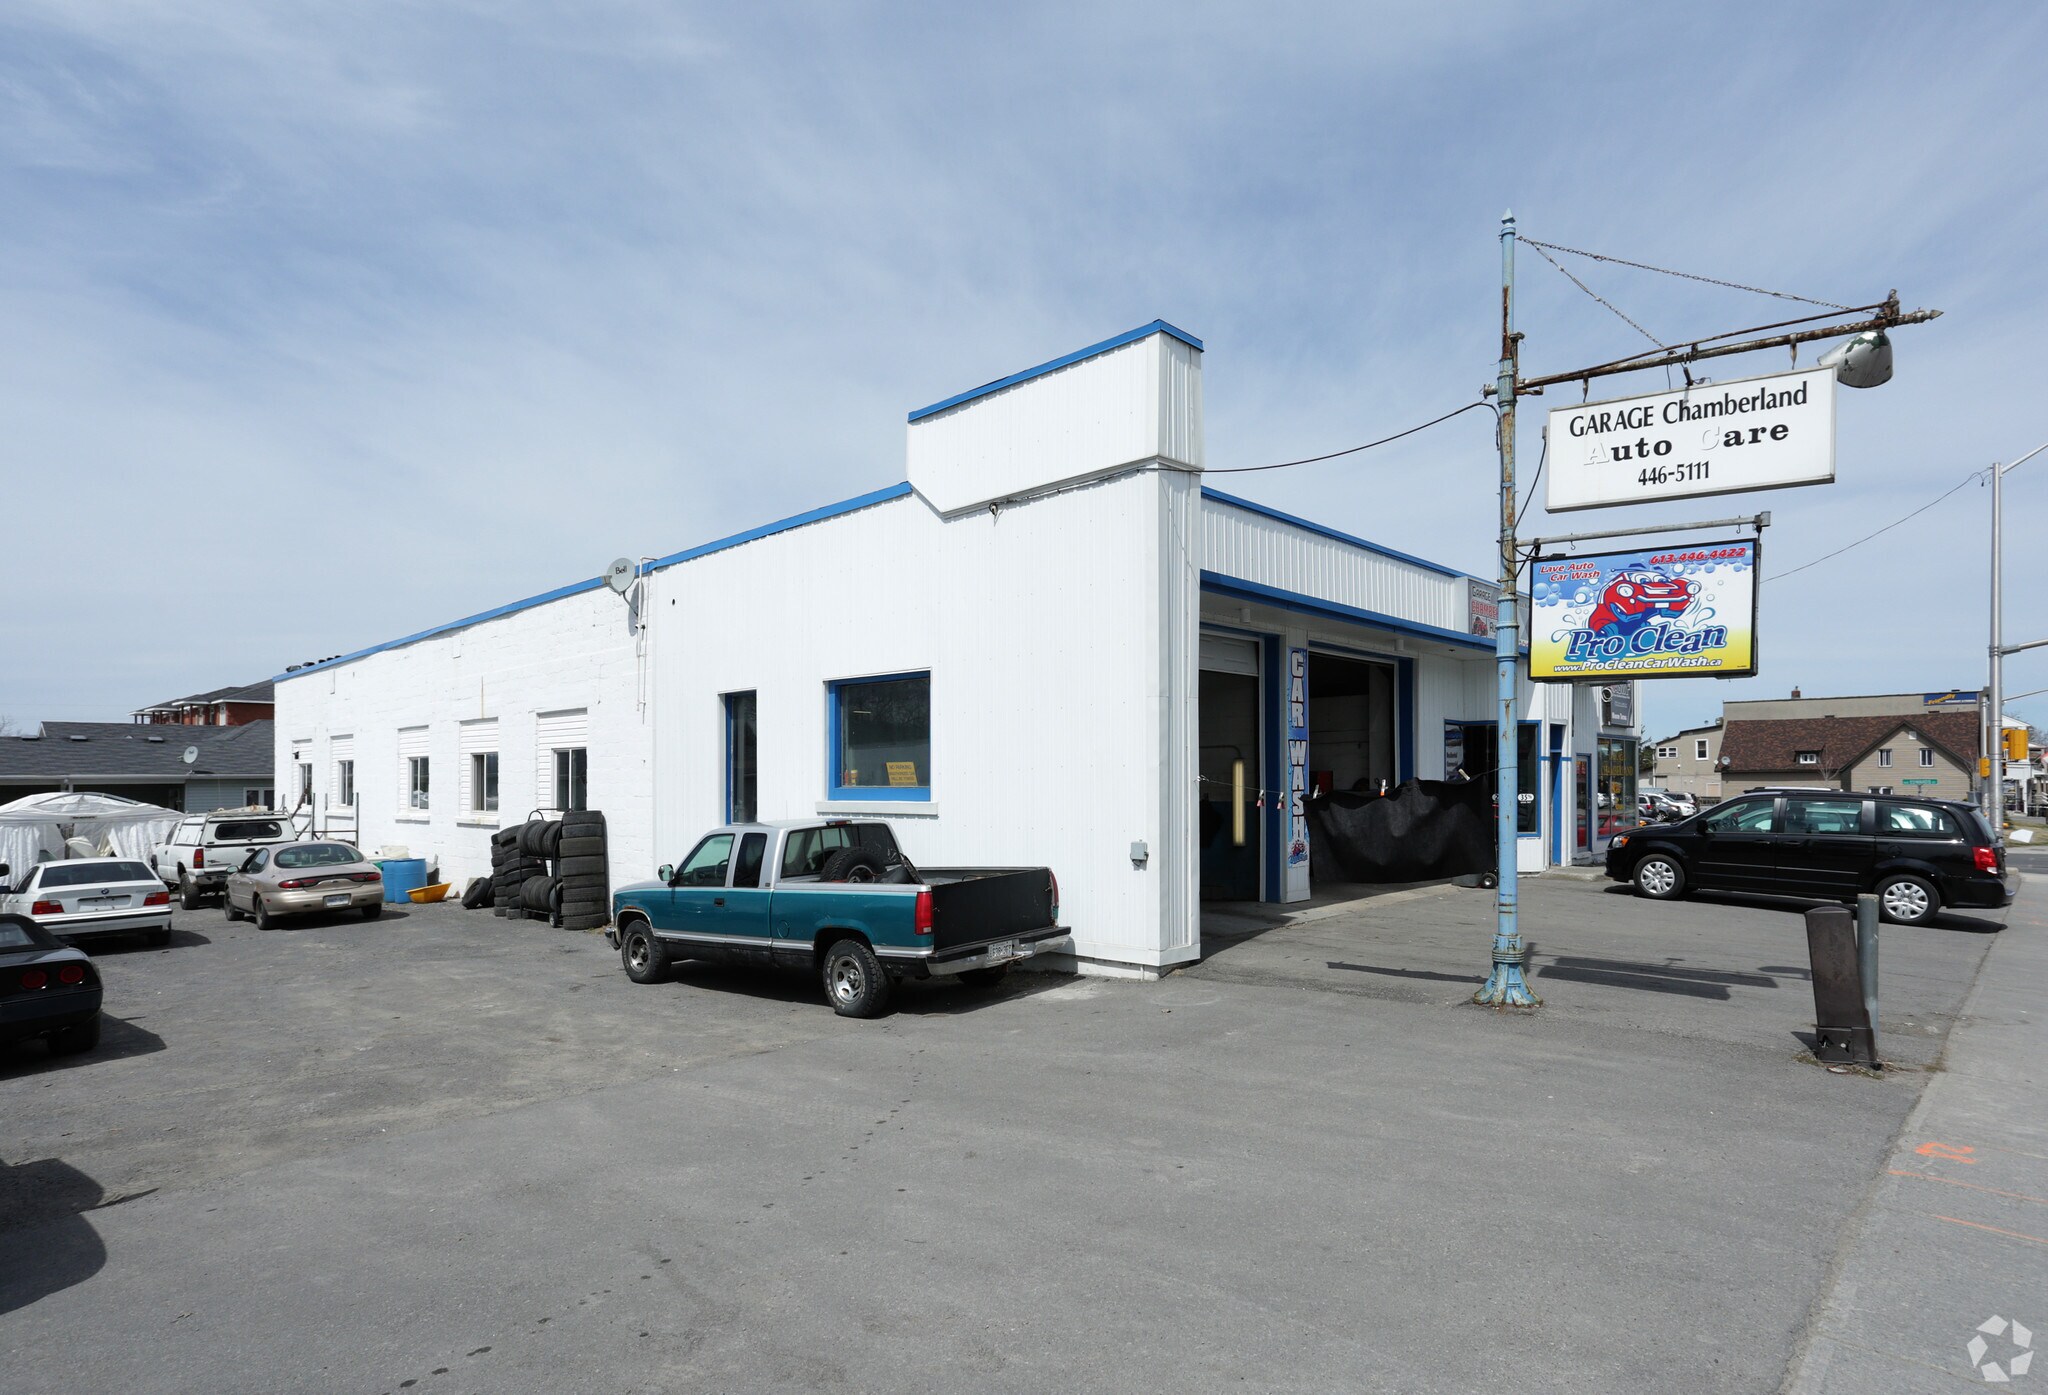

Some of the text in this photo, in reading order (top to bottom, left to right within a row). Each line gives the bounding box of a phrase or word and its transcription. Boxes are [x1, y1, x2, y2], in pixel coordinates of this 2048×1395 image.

[1569, 380, 1808, 438] GARAGE Chamberland
[1584, 424, 1789, 466] Auto Care
[1638, 460, 1710, 486] 446-5111
[1540, 561, 1595, 574] Lave Auto
[1650, 547, 1747, 565] 613.446.4422
[615, 565, 628, 575] Bell
[1549, 570, 1601, 582] Car Wash
[1472, 599, 1498, 620] CHAMBE
[1567, 622, 1728, 658] Pro Clean
[1553, 656, 1722, 672] www.ProCleanCarWash.ca
[1290, 650, 1305, 728] CAR
[1288, 739, 1307, 841] WASH
